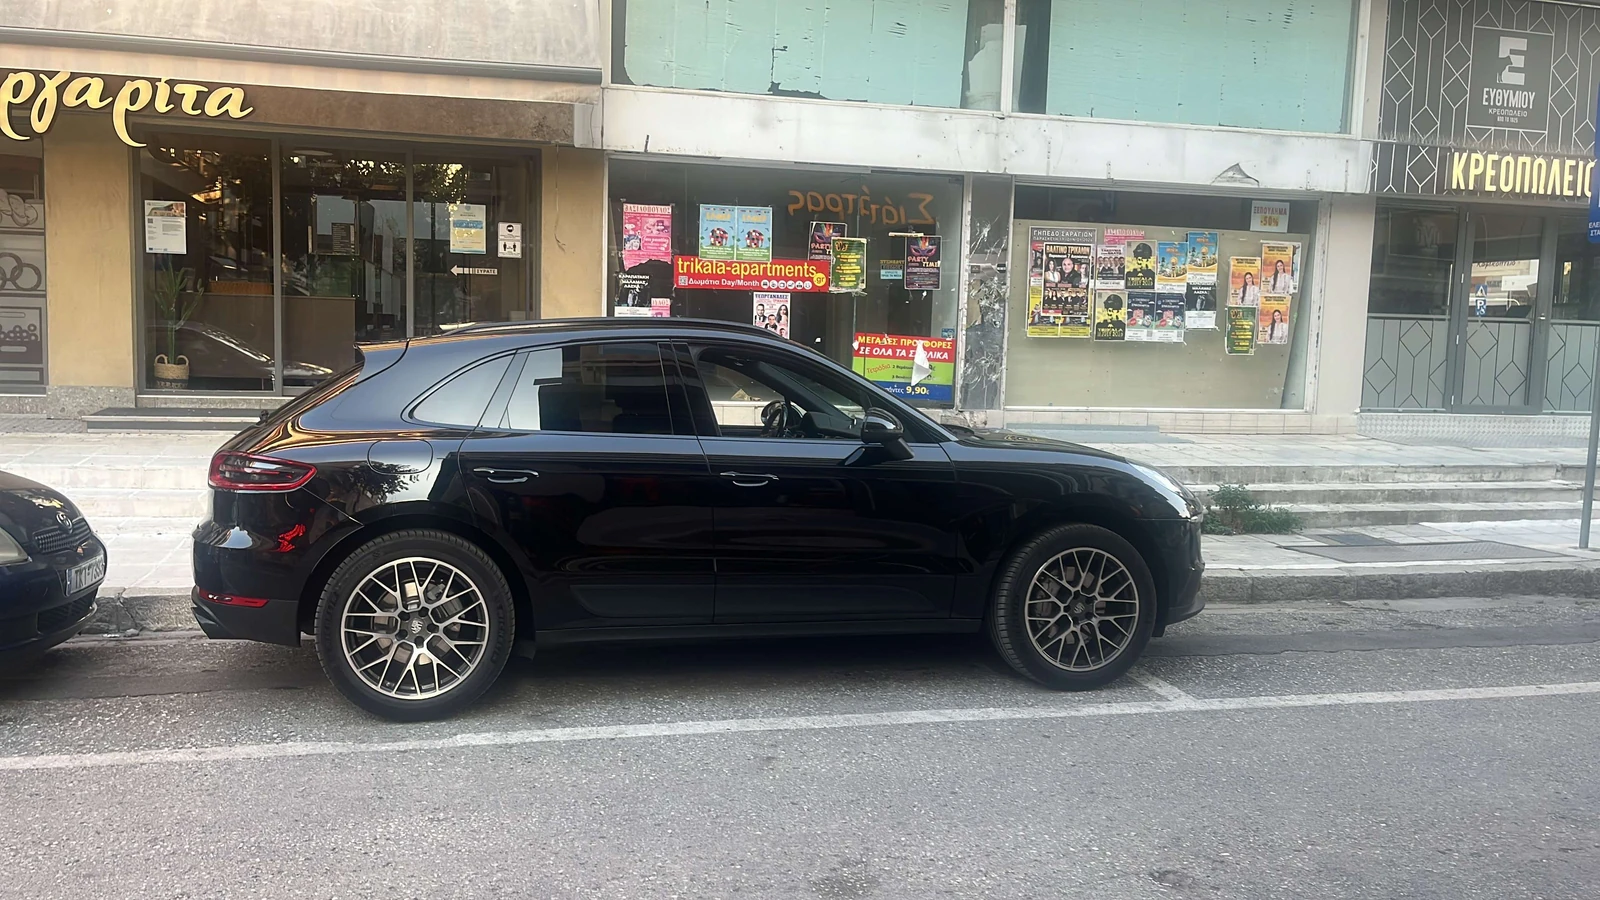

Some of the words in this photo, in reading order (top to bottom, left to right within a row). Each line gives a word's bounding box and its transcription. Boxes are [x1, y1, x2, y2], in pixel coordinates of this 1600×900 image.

[1482, 87, 1536, 109] ΕΥΘΥΜΙΟΥ
[1488, 108, 1528, 117] ΚΡΕΟΠΩΛΕΙΟ
[1253, 206, 1287, 215] ΞΕΠΟΥΛΗΜΑ
[1260, 216, 1279, 227] -50%
[1046, 245, 1067, 254] ΒΑΛΤΙΝΟ
[1068, 246, 1090, 255] ΤΡΙΚΑΛΩΝ
[678, 258, 816, 278] trikala-apartments
[721, 278, 759, 287] Day/Month
[900, 339, 953, 349] ΠΡΟΦΟΡΕΣ
[859, 346, 871, 354] ΣΕ
[872, 348, 893, 356] ΟΛΑ
[895, 349, 907, 357] ΤΑ
